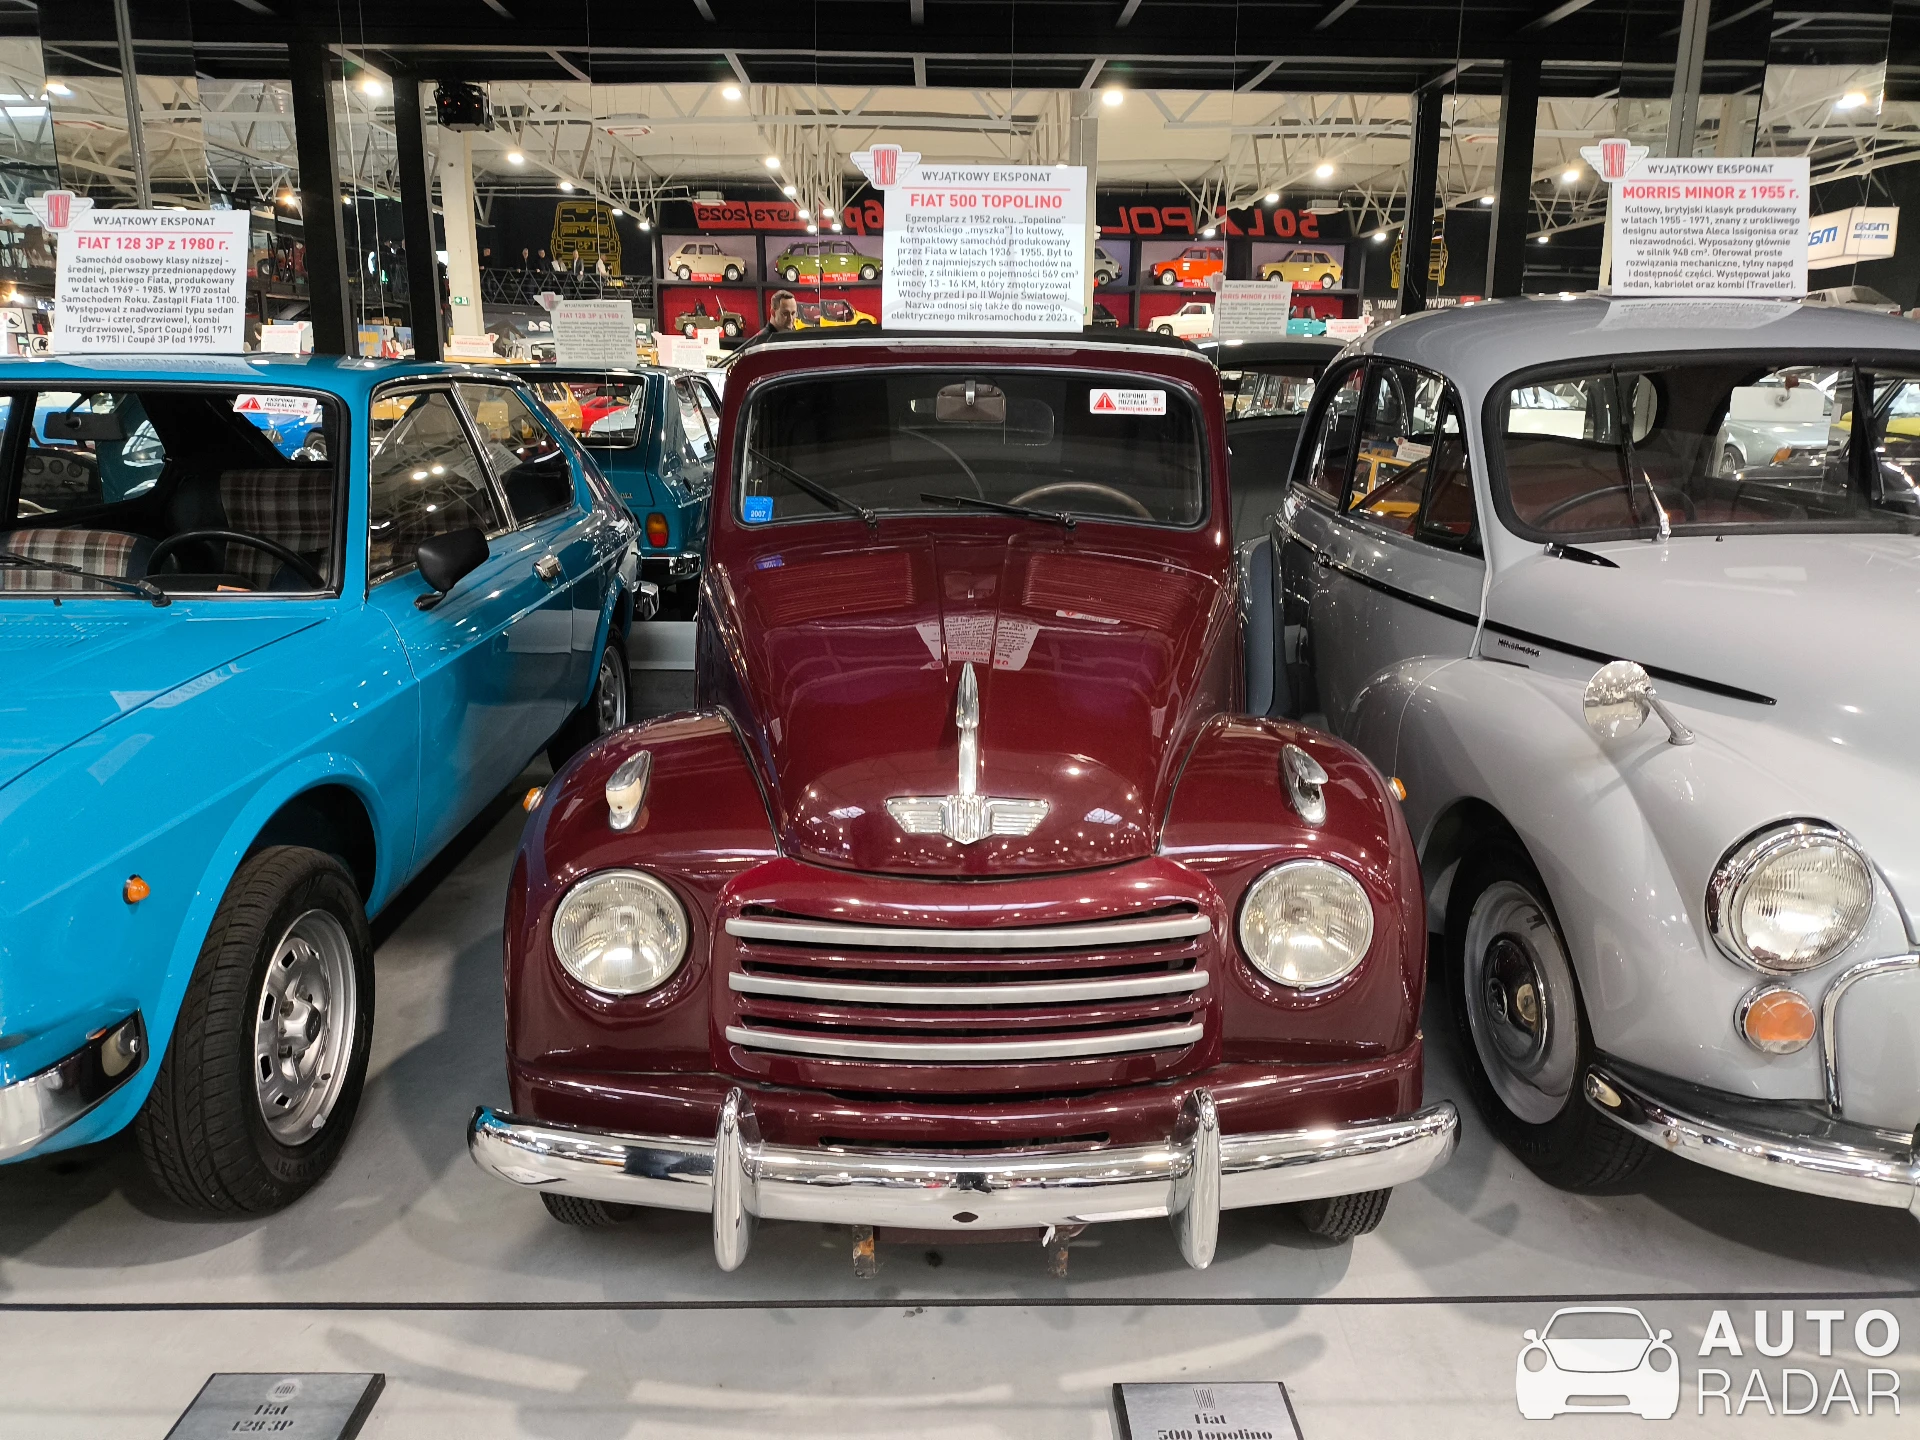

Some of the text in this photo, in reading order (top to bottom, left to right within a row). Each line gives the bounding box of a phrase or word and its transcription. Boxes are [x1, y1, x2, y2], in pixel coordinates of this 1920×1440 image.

[1647, 164, 1773, 175] WYJĄTKOWY EKSPONAT
[921, 172, 1051, 183] WYJĄTKOWY EKSPONAT
[1622, 186, 1798, 199] MORRIS MINOR z 1955 r.
[910, 194, 1062, 208] FIAT 500 TOPOLINO
[1624, 205, 1796, 215] Kultowy, brytyjski klasyk produkowany
[93, 217, 215, 227] WYJĄTKOWY EKSPONAT
[1630, 216, 1800, 226] latach 1971, znany urokliwego
[1622, 227, 1656, 236] designu
[1659, 227, 1703, 235] autorstwa
[1705, 227, 1729, 235] Aleca
[1732, 227, 1776, 237] Issigonisa
[77, 237, 228, 250] FIAT 128 3P z 1980 r.
[1629, 237, 1790, 247] niezawodności. Wyposażony głównie
[1646, 248, 1782, 258] silnik Oferował proste
[75, 256, 222, 266] Samochód osobowy klasy niższej
[1625, 259, 1793, 269] rozwiązania mechaniczne, tylny napęd
[67, 266, 236, 276] średniej, pierwszy przednionapędowy
[1633, 269, 1769, 279] dostępność części. Występował
[98, 276, 144, 285] włoskiego
[146, 276, 171, 285] Fiata,
[174, 276, 234, 285] produkowany
[1623, 280, 1651, 290] sedan,
[1654, 280, 1693, 288] kabriolet
[1717, 280, 1744, 288] kombi
[81, 285, 109, 293] latach
[203, 286, 229, 294] został
[124, 296, 149, 304] Roku.
[152, 296, 188, 305] Zastąpił
[190, 296, 212, 304] Fiata
[216, 296, 239, 304] 1100.
[65, 305, 120, 314] Występował
[207, 306, 233, 314] sedan
[192, 316, 219, 324] kombi
[137, 326, 162, 335] Sport
[164, 326, 192, 335] Coupé
[127, 336, 155, 345] Coupé
[232, 1420, 294, 1432] 128 3P
[1157, 1430, 1192, 1440] 500
